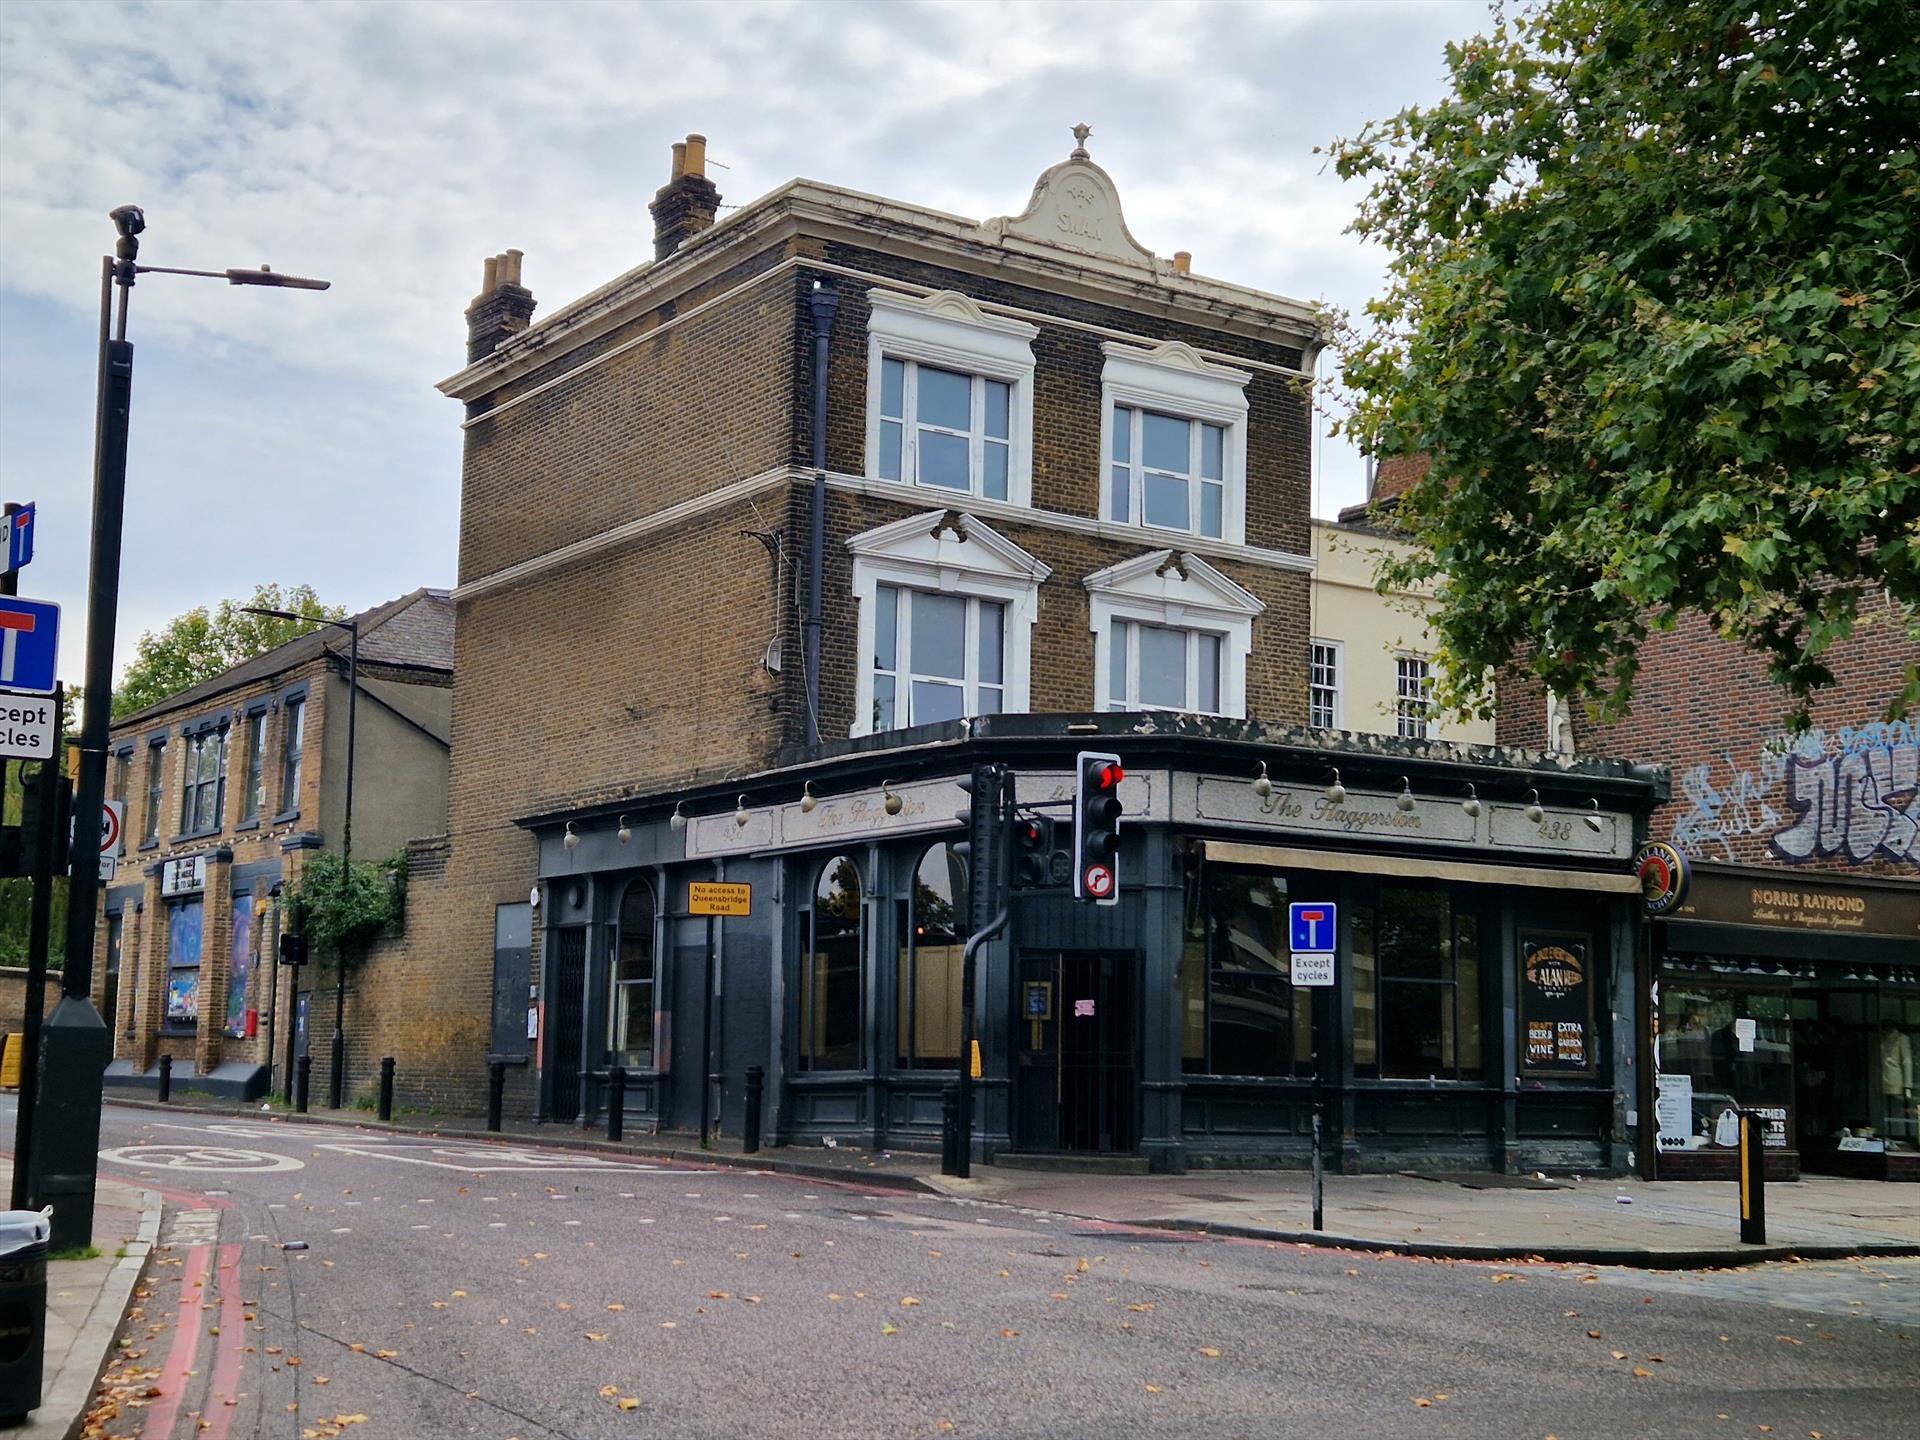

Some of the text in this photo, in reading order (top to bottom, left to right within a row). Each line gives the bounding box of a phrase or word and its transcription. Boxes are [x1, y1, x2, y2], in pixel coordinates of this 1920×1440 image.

[1259, 791, 1423, 831] The Haggerston
[1537, 821, 1573, 841] 438
[694, 885, 706, 893] No
[737, 887, 746, 895] to
[692, 894, 748, 904] Queensbridge
[1752, 888, 1866, 913] NORRIS RAYMOND
[709, 903, 730, 912] Road
[1295, 958, 1330, 970] Except
[1297, 970, 1328, 981] cycles
[1557, 1022, 1583, 1033] EXTRA
